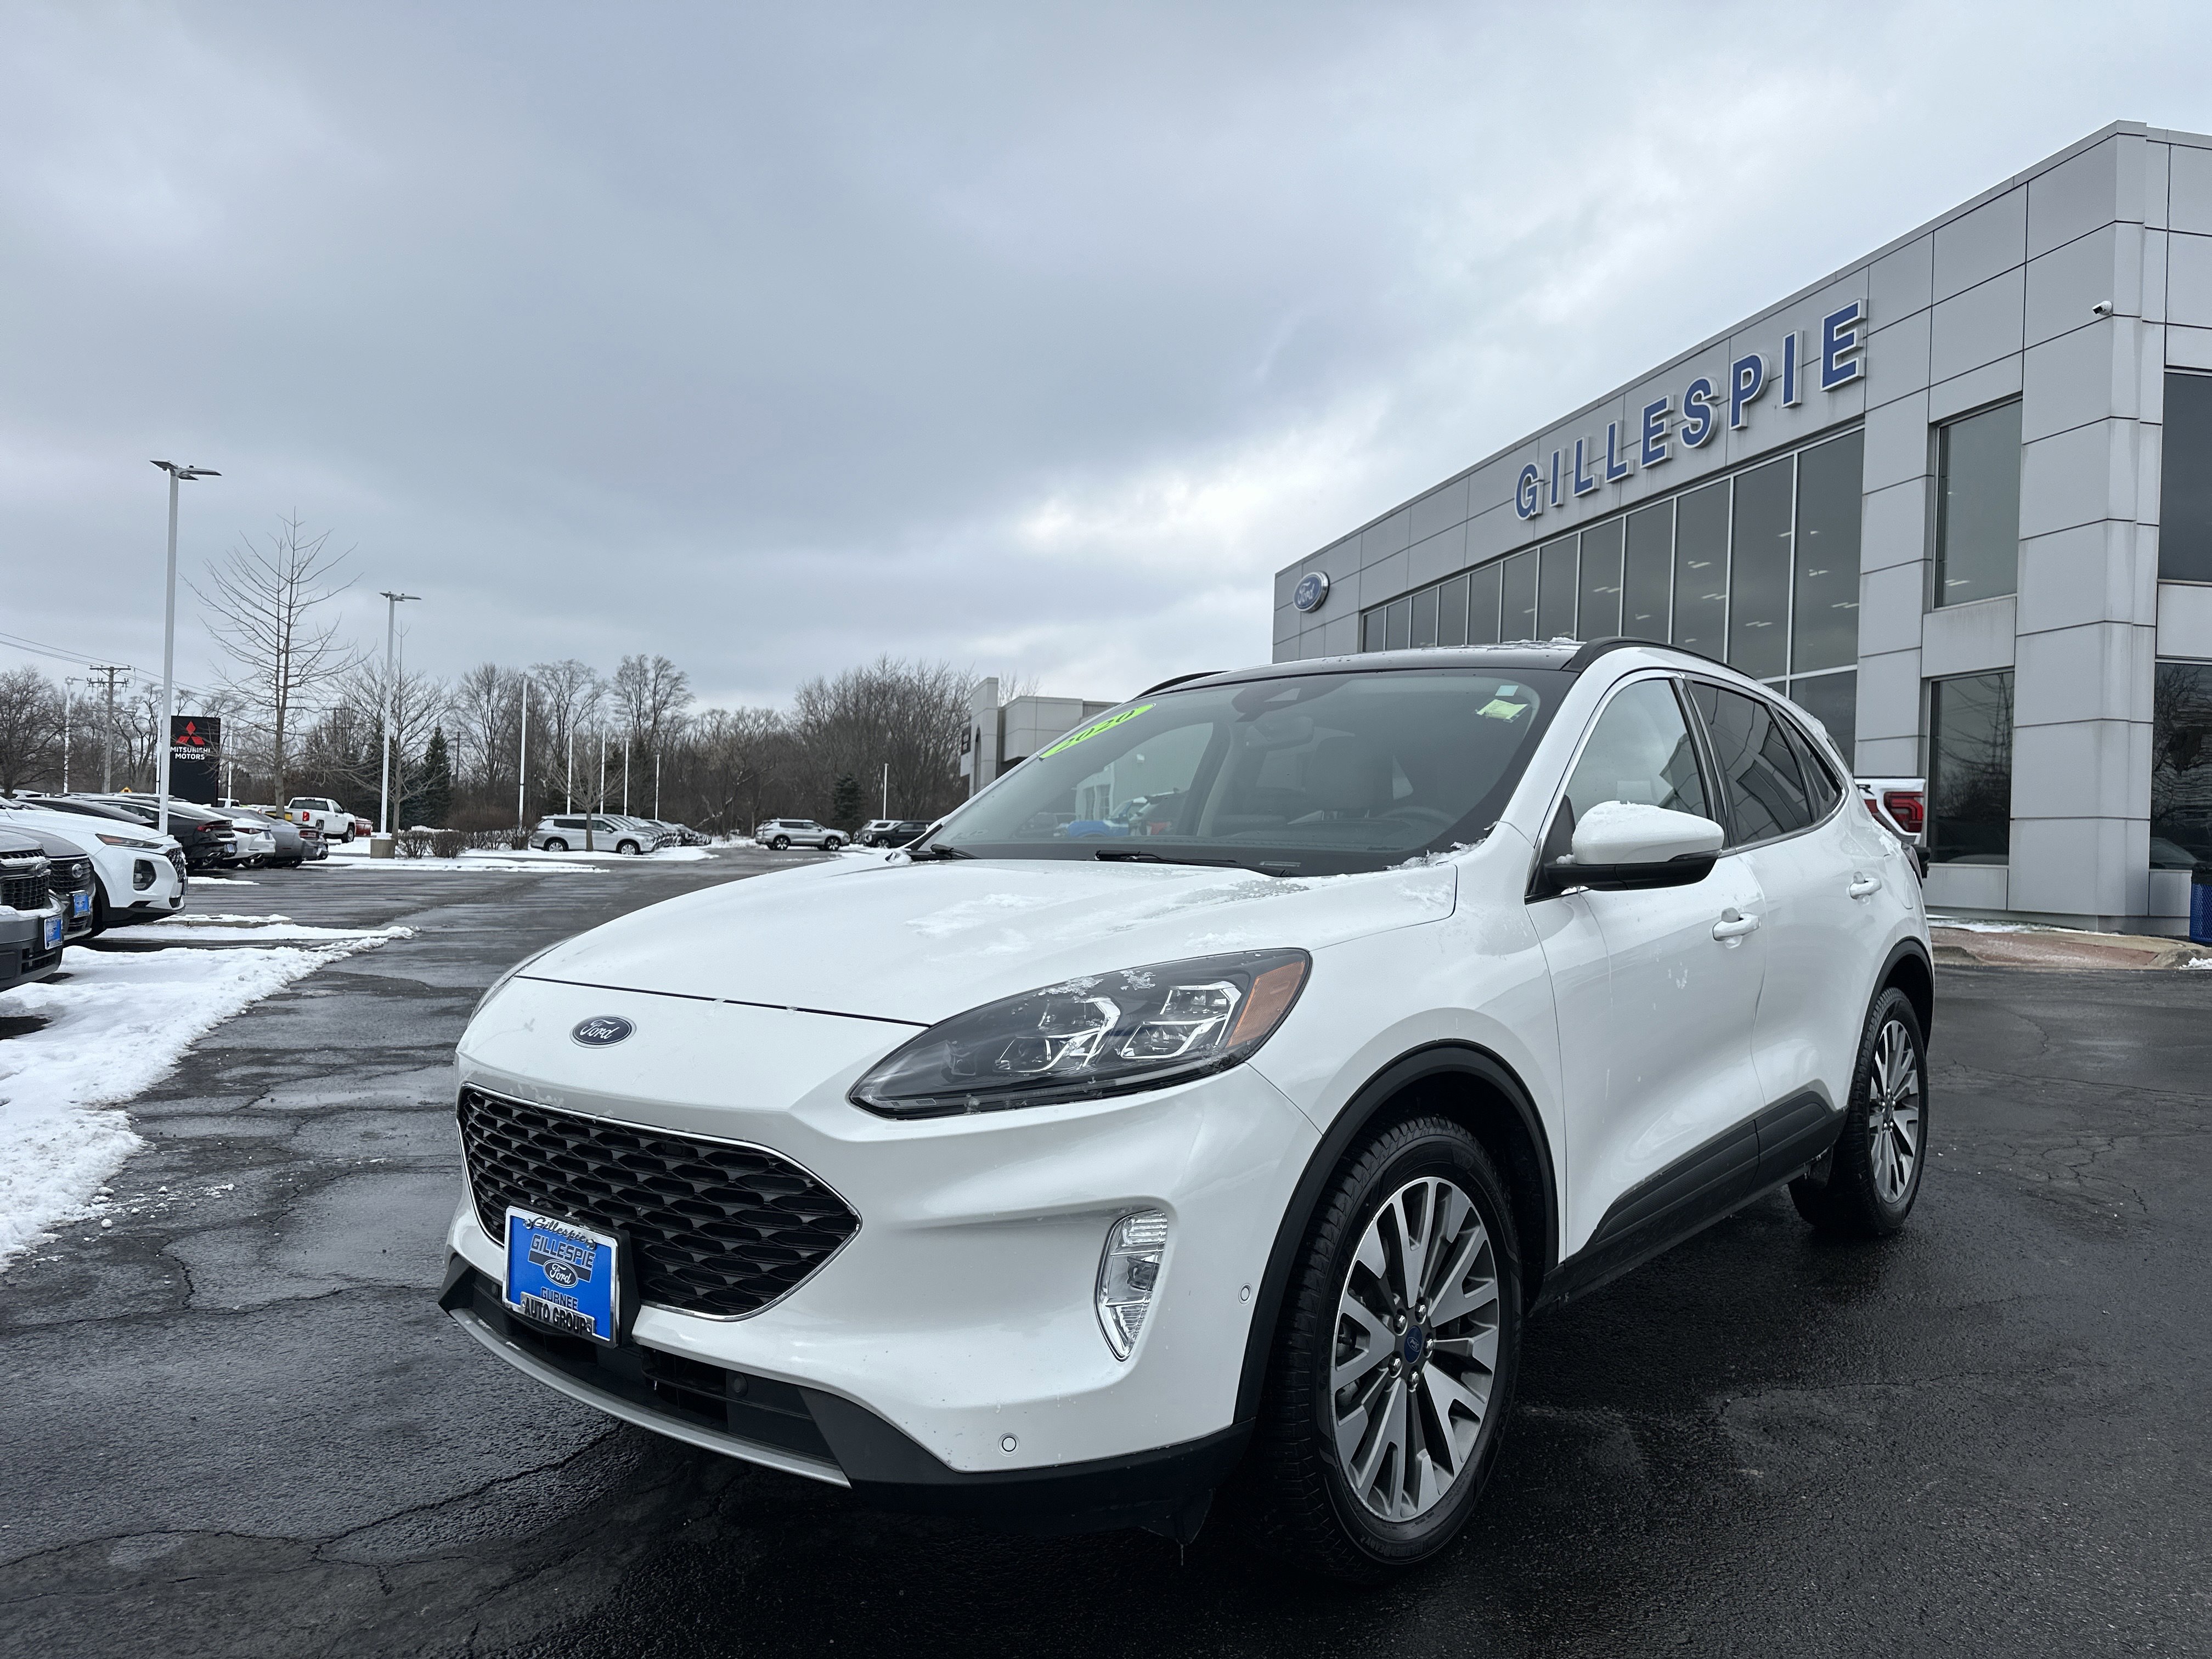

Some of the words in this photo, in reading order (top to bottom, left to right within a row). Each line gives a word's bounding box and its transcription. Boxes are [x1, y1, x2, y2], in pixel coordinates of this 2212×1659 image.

[1514, 299, 1866, 520] GILLESPIE
[1054, 710, 1135, 753] 2020
[580, 1019, 620, 1039] Ford
[532, 1216, 588, 1242] Gillespie
[531, 1233, 596, 1269] GILLESPIE
[549, 1263, 572, 1284] Ford
[540, 1286, 579, 1311] GURNEE
[524, 1297, 551, 1320] AUTO
[553, 1307, 588, 1335] GROUP
